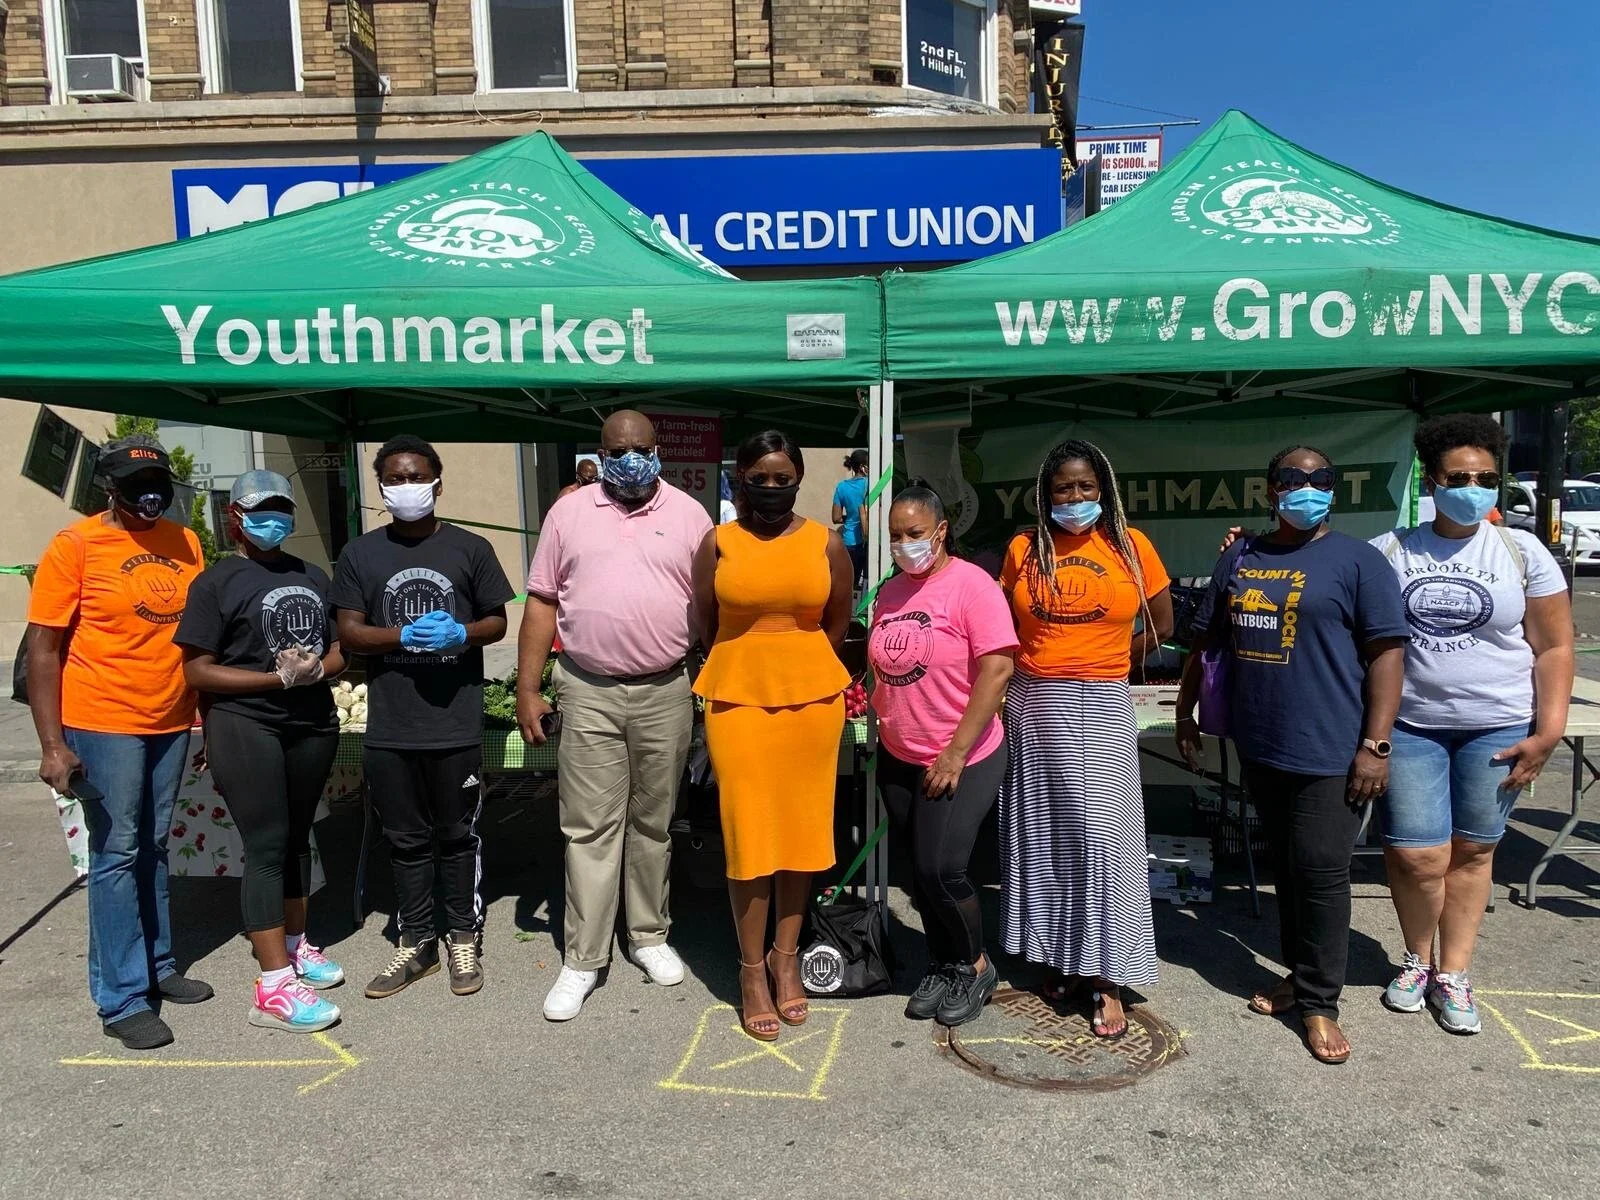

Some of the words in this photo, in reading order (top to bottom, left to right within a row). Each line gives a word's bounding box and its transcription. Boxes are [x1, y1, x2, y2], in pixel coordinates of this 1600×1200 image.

[920, 40, 945, 58] 2nd
[947, 48, 967, 65] FL.
[920, 55, 926, 67] 1
[928, 57, 953, 75] Hillel
[954, 65, 967, 79] Pl.
[1089, 142, 1121, 155] PRIME
[1123, 141, 1147, 154] TIME
[1222, 159, 1300, 175] TEACH
[469, 182, 548, 202] TEACH
[368, 192, 441, 232] GARDEN
[1171, 182, 1205, 224] GARDEN
[714, 209, 878, 252] CREDIT
[887, 204, 1034, 248] UNION
[440, 238, 507, 254] NYC
[160, 304, 655, 366] Youthmarket
[662, 420, 715, 432] farm-fresh
[682, 434, 702, 444] and
[661, 447, 706, 458] getables!
[681, 468, 706, 491] $5
[402, 569, 438, 581] ELITE
[1238, 568, 1291, 580] COUNT
[1403, 562, 1500, 585] BROOKLYN
[403, 584, 417, 594] ONE
[418, 584, 440, 597] TEACH
[1281, 591, 1302, 649] BLOCK
[1409, 632, 1481, 653] BRANCH
